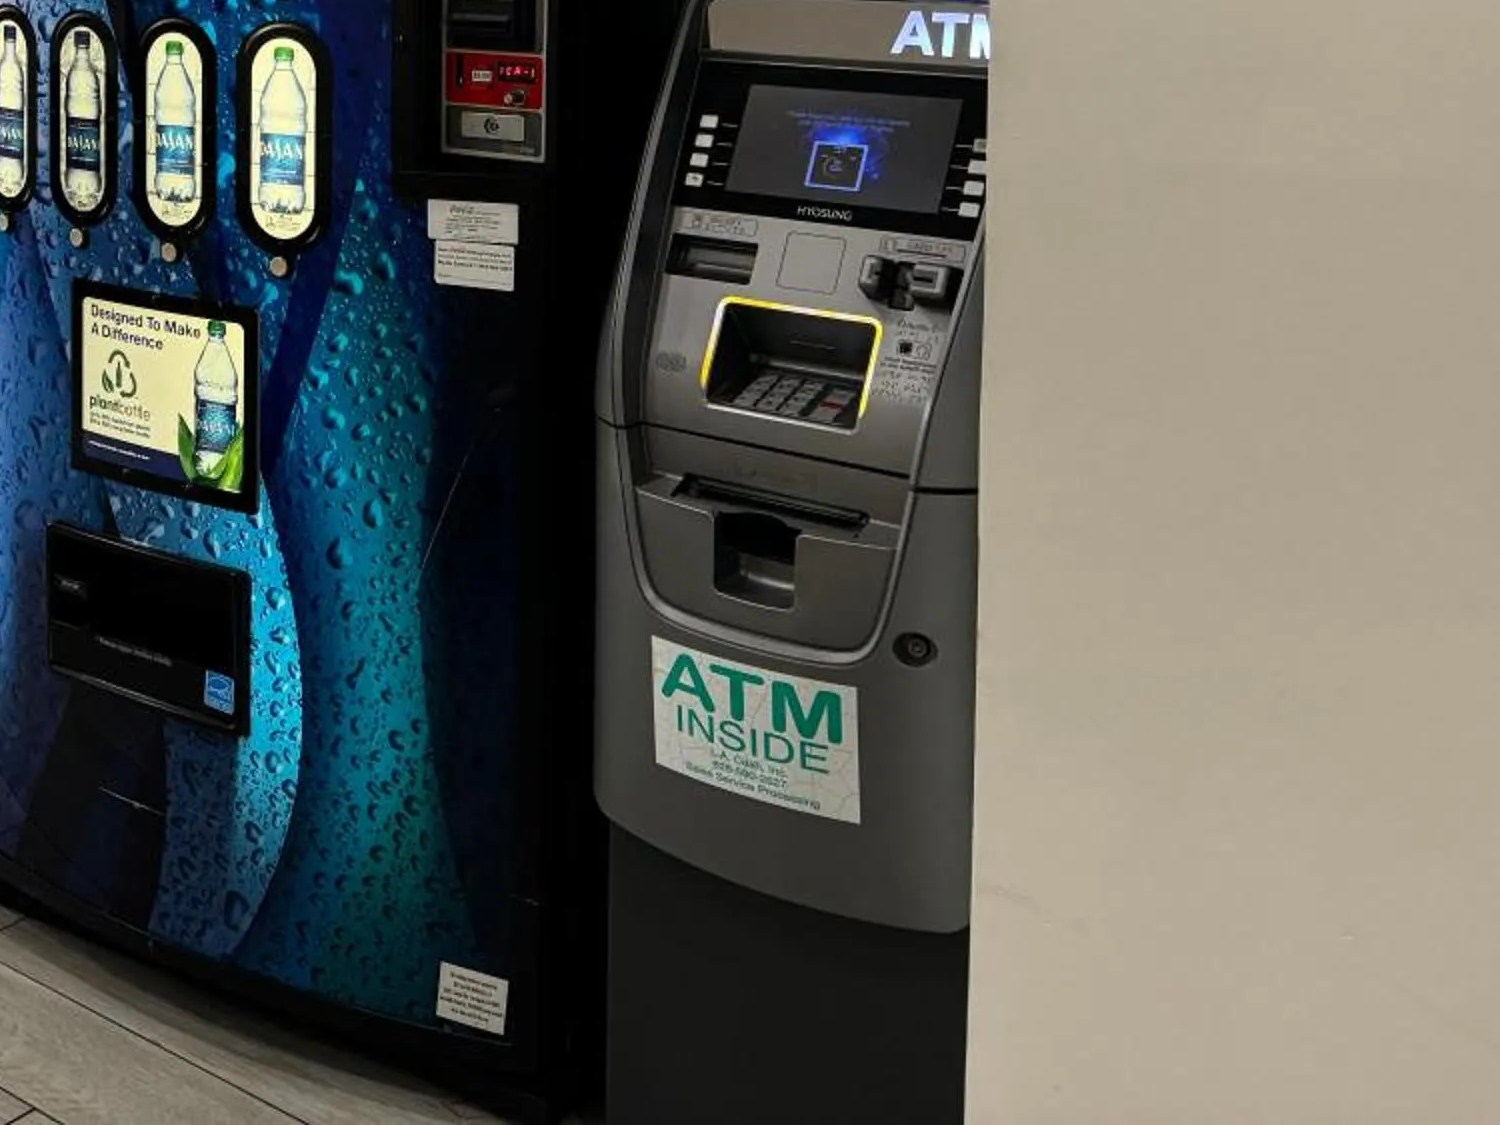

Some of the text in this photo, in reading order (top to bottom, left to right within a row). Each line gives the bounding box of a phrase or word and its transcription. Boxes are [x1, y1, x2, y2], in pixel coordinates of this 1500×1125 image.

[796, 204, 853, 222] HYOSUNG
[91, 303, 201, 340] Designed To Make
[91, 322, 164, 351] A Difference
[661, 652, 843, 746] ATM
[677, 704, 830, 774] INSIDE
